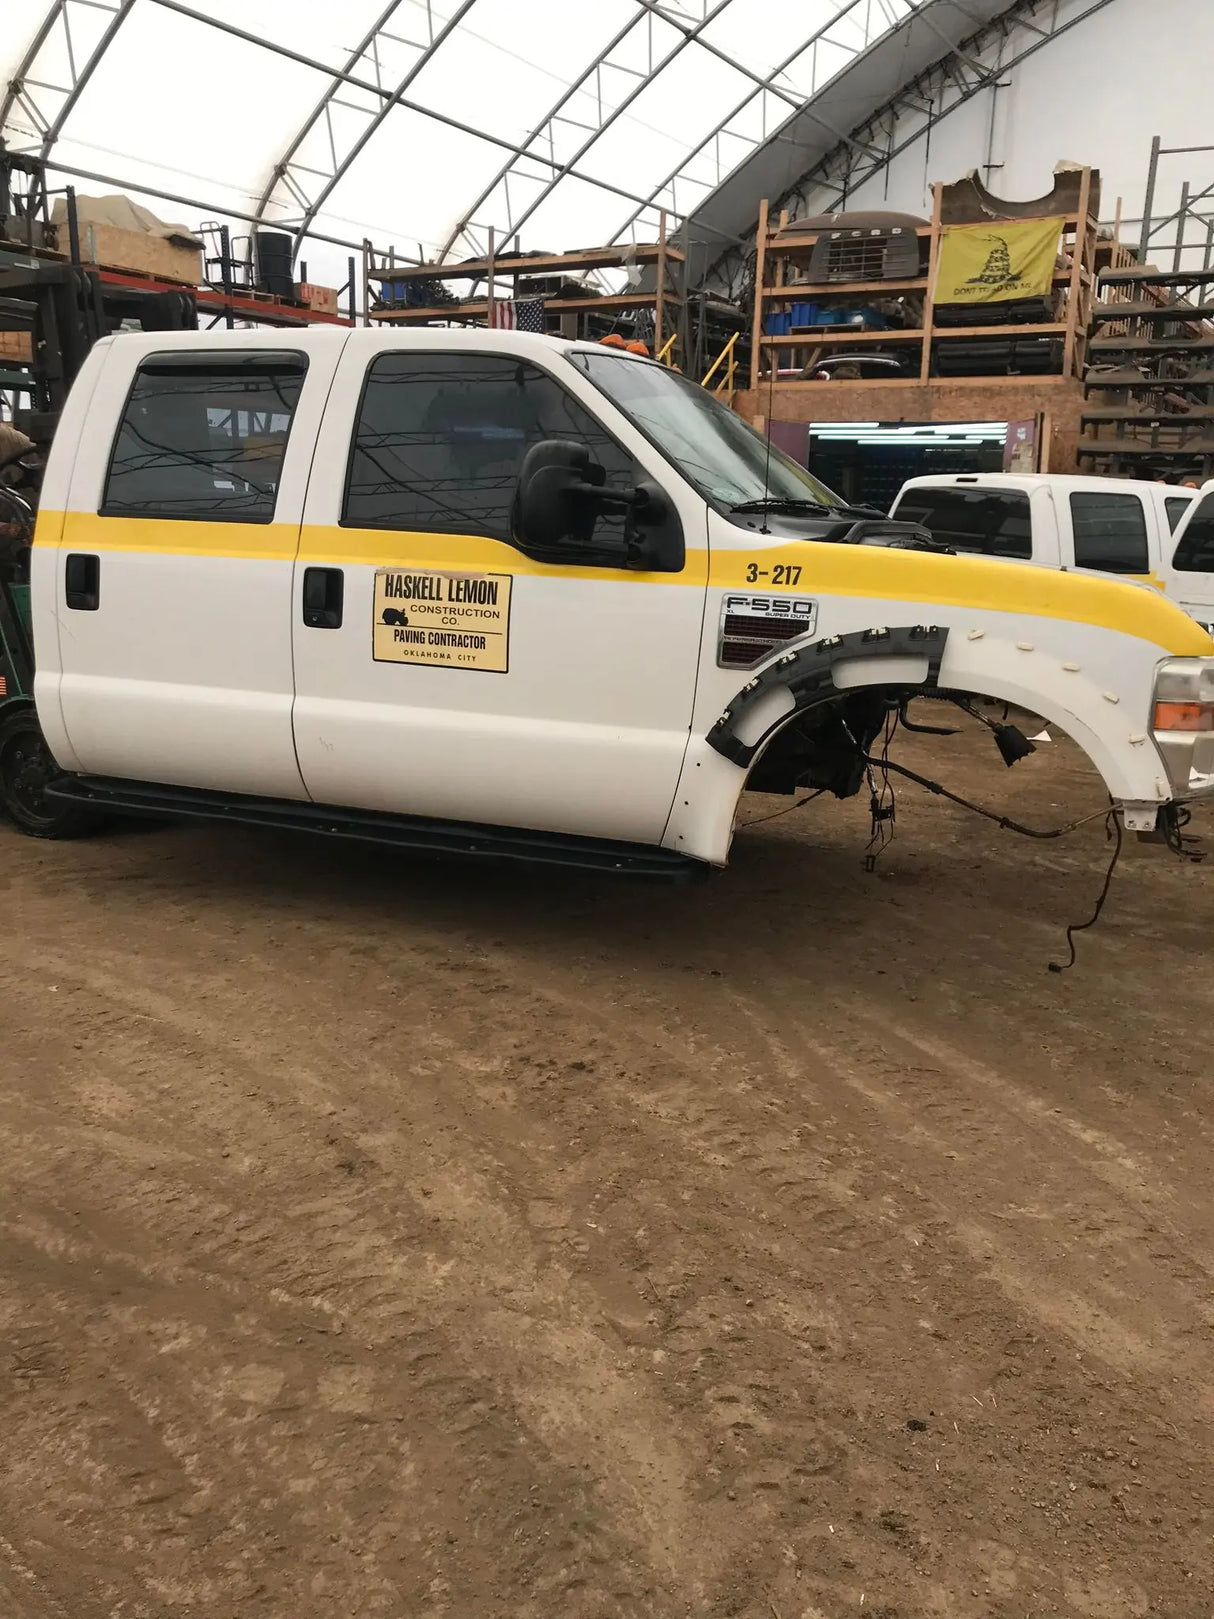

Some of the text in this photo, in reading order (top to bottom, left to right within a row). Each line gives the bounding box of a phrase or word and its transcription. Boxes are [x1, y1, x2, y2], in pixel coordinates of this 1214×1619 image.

[384, 574, 499, 605] HASKELL LEMON
[410, 604, 500, 619] CONSTRUCTION
[726, 597, 813, 614] F-550
[441, 616, 460, 626] CO.
[393, 629, 486, 650] PAVING CONTRACTOR
[403, 649, 477, 662] OKLAHOMA CITY
